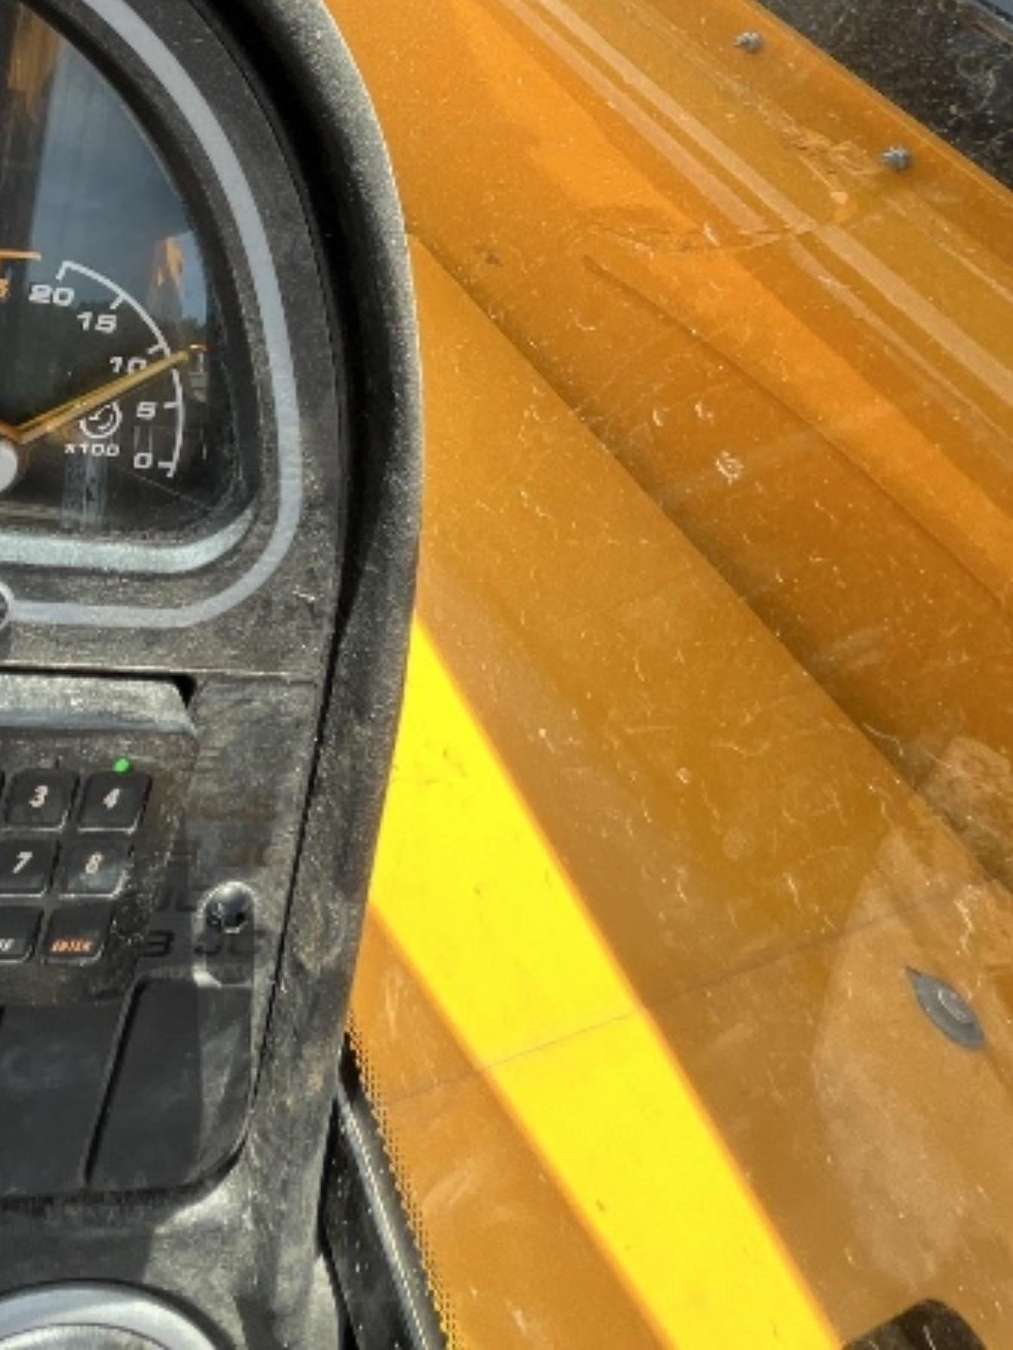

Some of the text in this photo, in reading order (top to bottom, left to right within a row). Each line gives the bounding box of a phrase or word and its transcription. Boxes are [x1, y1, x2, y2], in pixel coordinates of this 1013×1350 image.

[28, 283, 75, 307] 20
[77, 311, 117, 334] 15
[109, 356, 148, 377] 10
[136, 401, 157, 419] 5
[133, 452, 153, 470] 0
[29, 784, 49, 808] 3
[103, 787, 121, 810] 4
[12, 851, 33, 874] 7
[85, 852, 104, 875] 8
